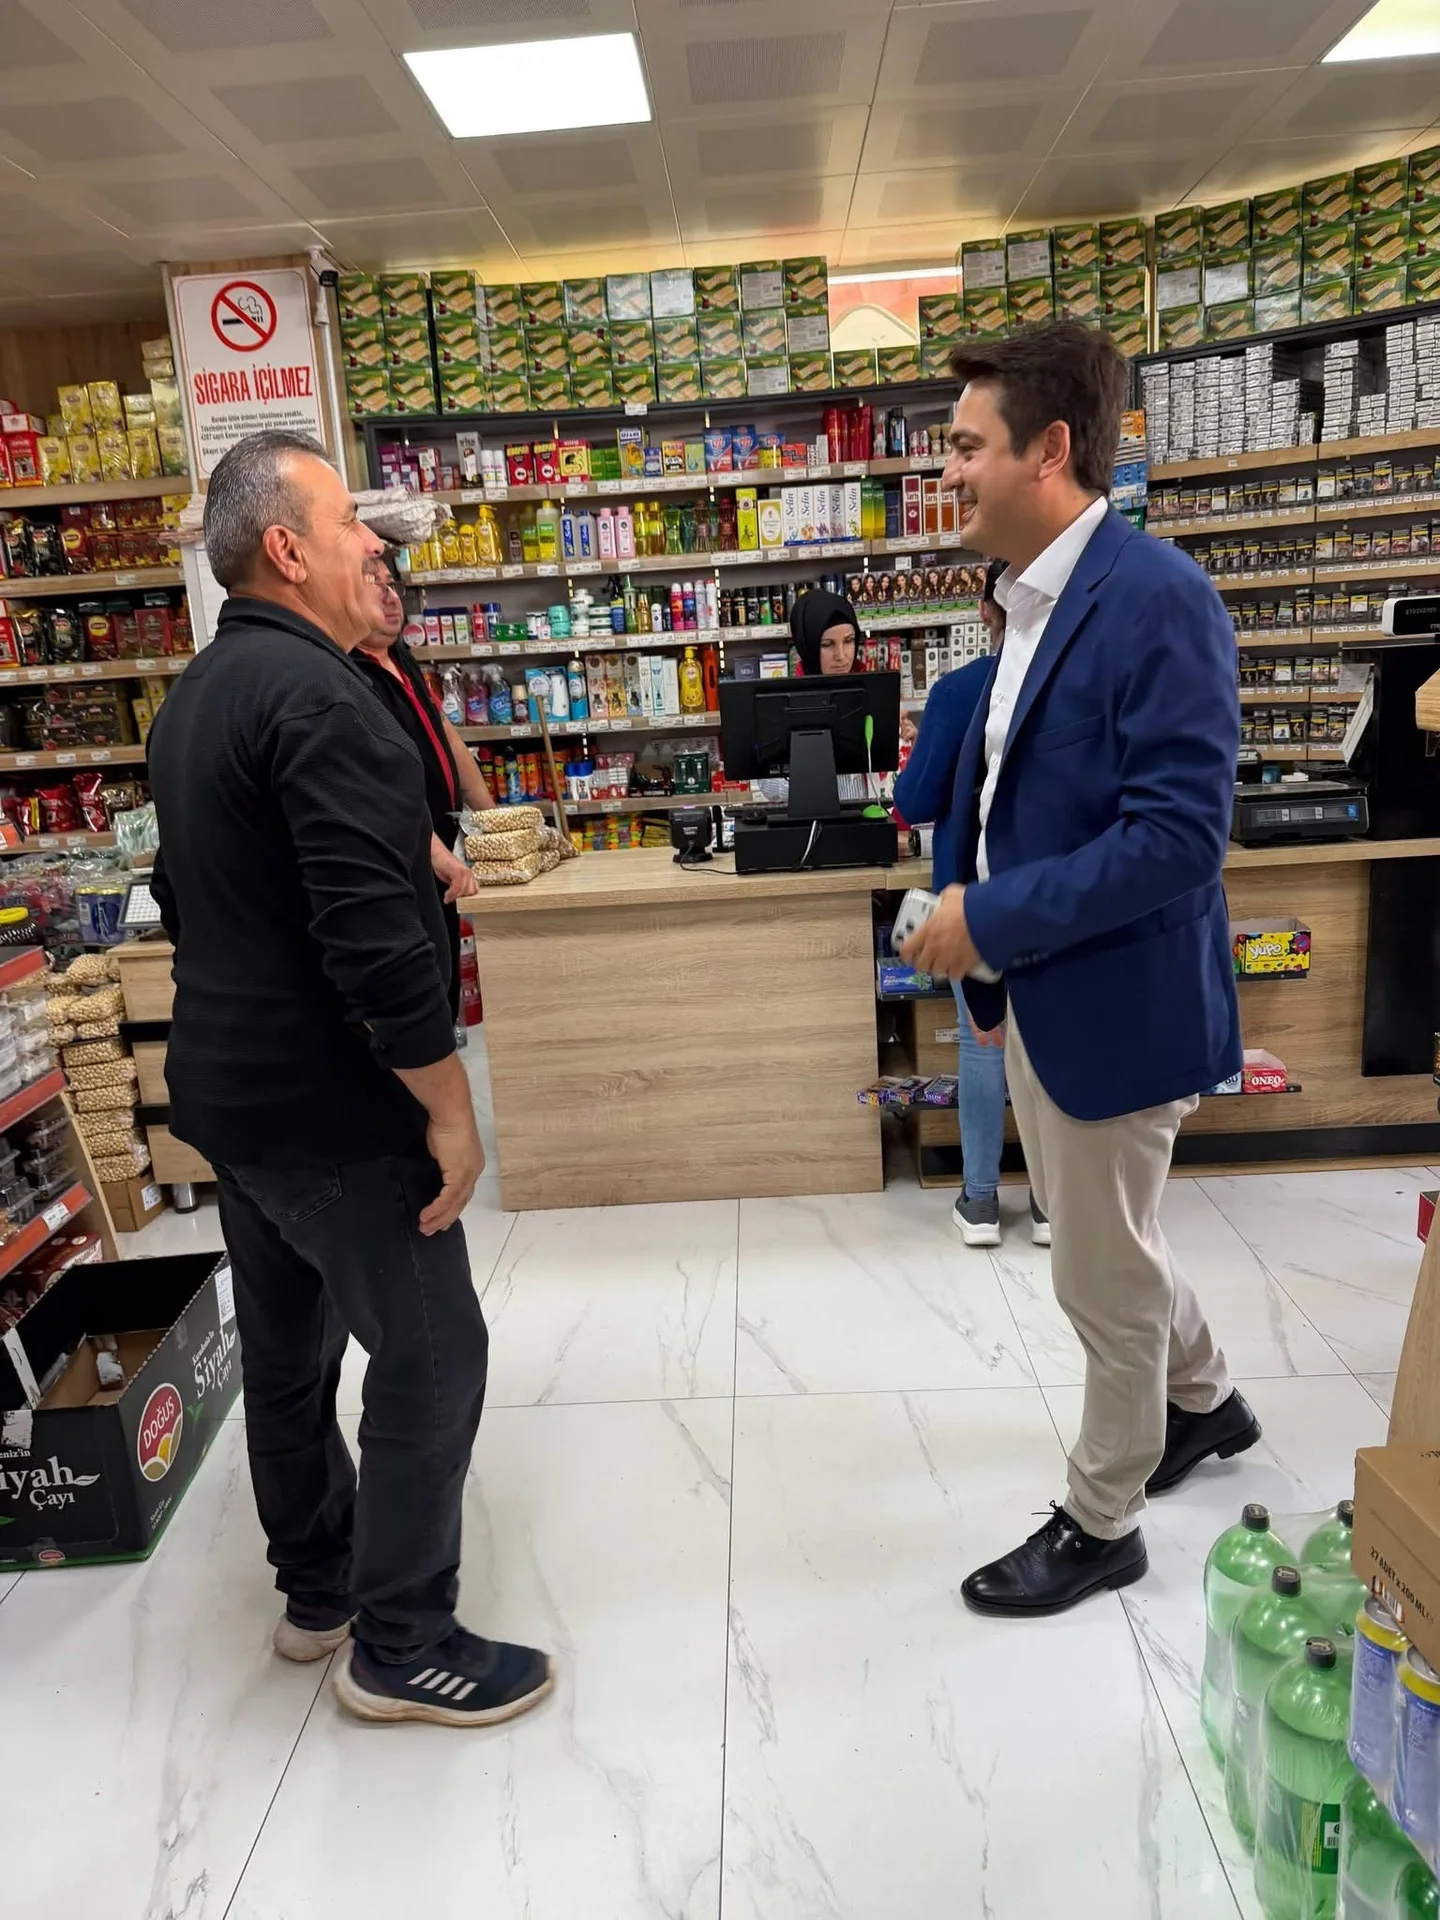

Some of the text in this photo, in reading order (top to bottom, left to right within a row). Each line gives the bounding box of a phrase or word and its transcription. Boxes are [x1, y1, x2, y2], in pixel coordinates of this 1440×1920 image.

[193, 361, 313, 405] SİGARA İÇİLMEZ
[785, 492, 795, 518] Selin
[801, 491, 810, 516] Selin
[817, 490, 826, 515] Selin
[832, 489, 841, 515] Selin
[848, 487, 857, 512] Selin
[194, 1325, 232, 1399] Siyah
[143, 1395, 175, 1450] DOĞUŞ
[29, 1488, 76, 1511] Çayı
[1370, 1545, 1379, 1561] 27
[1379, 1556, 1396, 1582] ADET
[1415, 1597, 1426, 1618] ML
